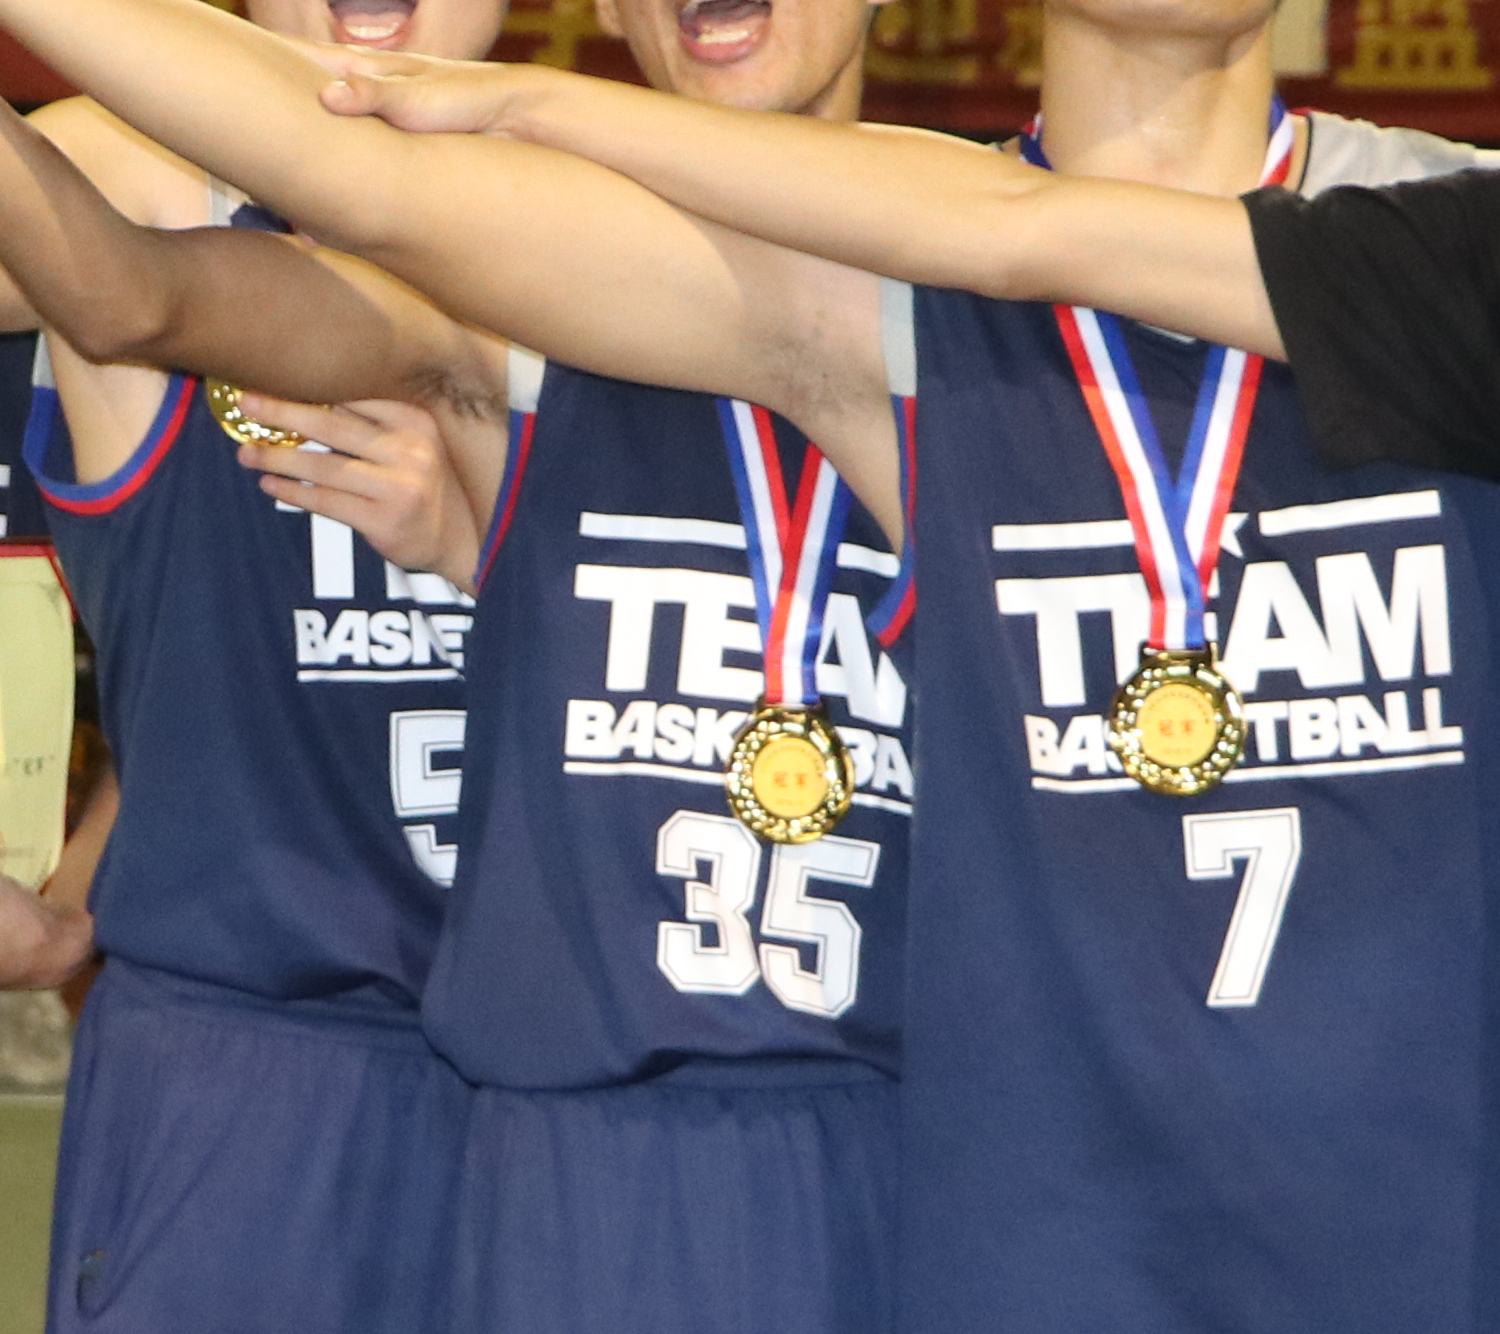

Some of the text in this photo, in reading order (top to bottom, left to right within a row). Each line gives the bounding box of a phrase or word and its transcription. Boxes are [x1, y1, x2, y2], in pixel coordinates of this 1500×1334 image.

[1024, 687, 1464, 777] BATBALL
[656, 810, 879, 1020] 35
[1183, 807, 1302, 1009] 7
